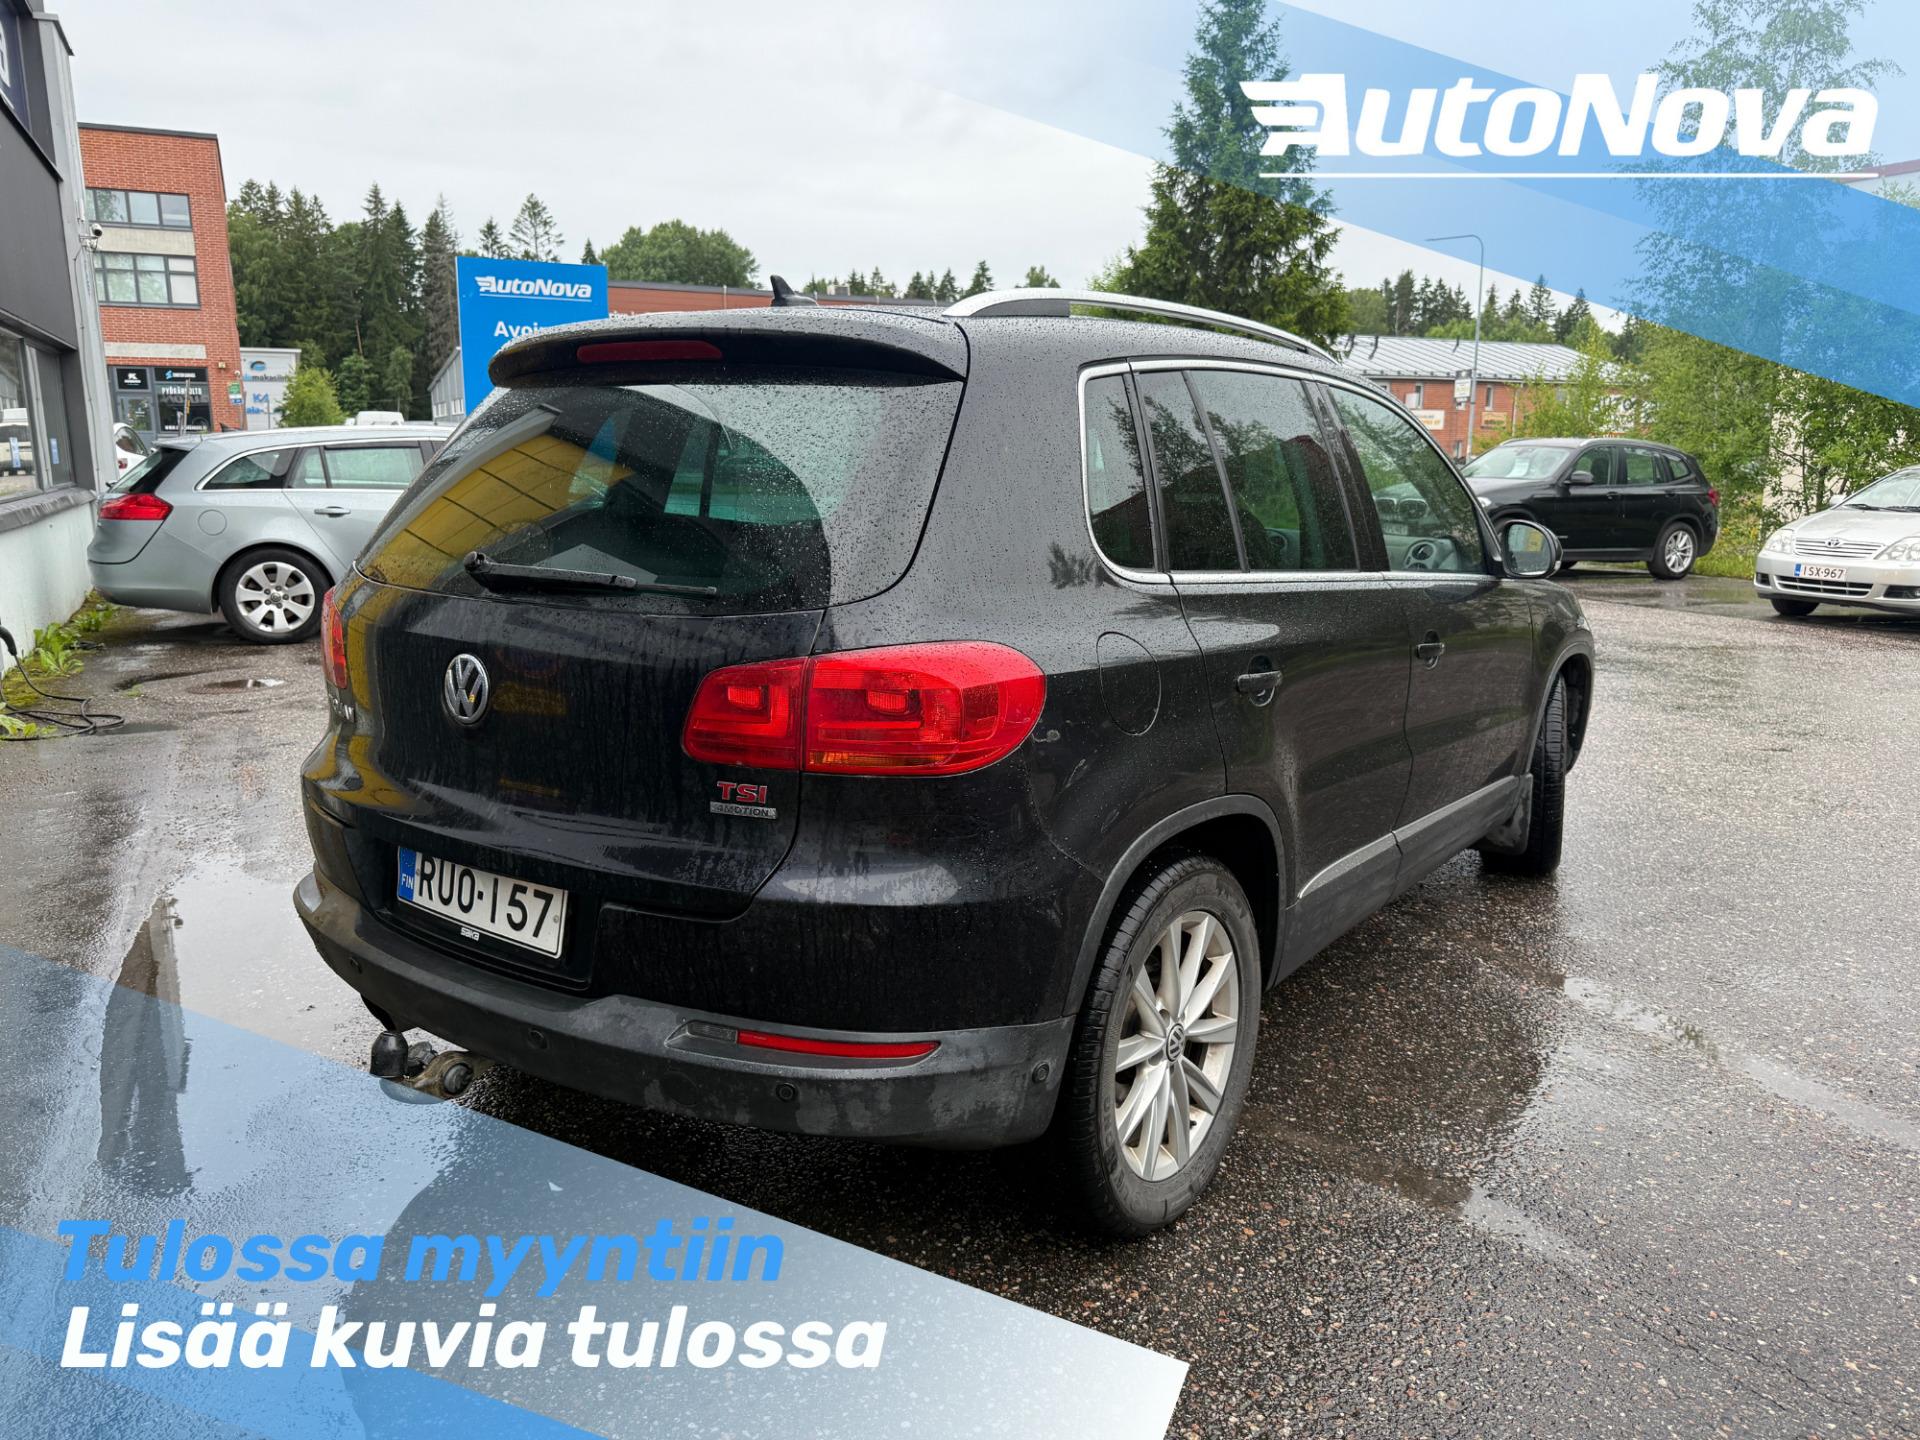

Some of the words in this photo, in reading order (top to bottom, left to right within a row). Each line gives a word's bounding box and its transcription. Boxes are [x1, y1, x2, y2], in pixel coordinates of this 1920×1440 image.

[474, 276, 592, 298] AutoNova
[717, 781, 767, 804] TSI
[418, 852, 555, 939] RUO-157
